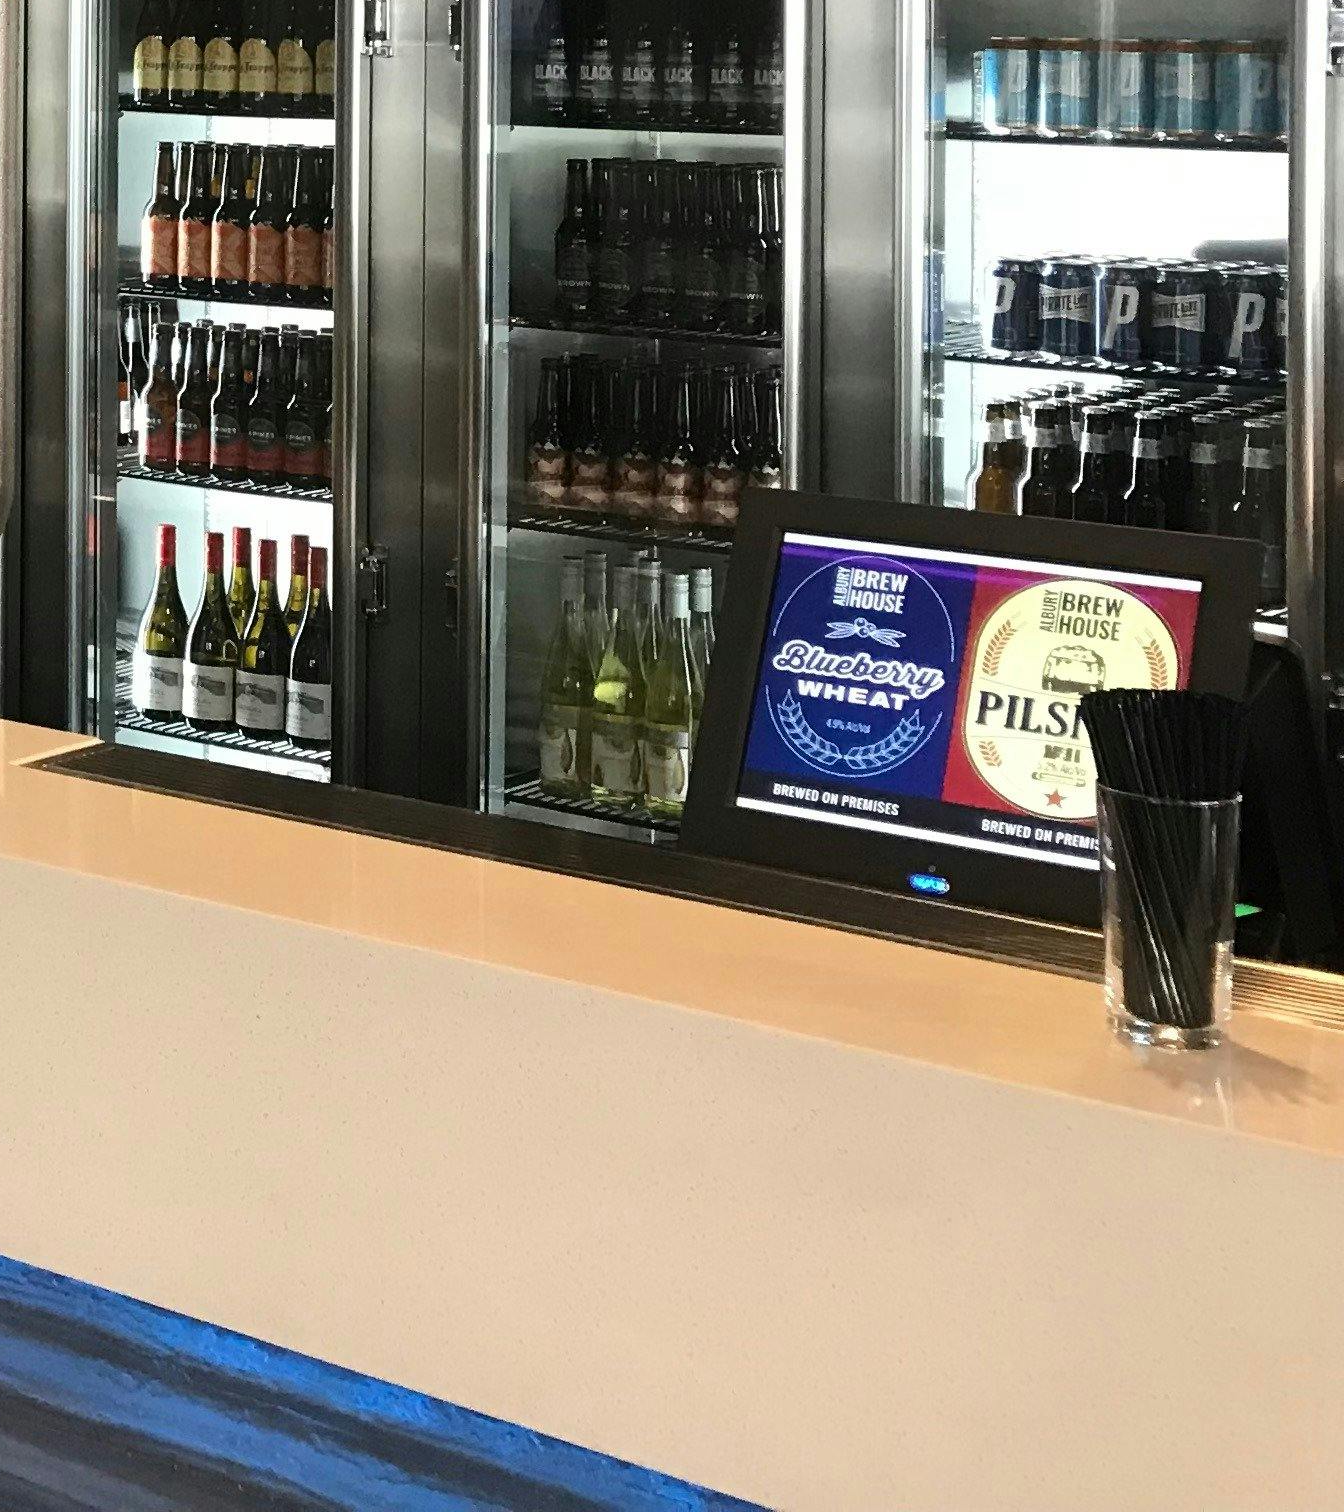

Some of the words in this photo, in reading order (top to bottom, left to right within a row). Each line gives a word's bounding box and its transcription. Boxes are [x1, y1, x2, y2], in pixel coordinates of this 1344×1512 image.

[833, 565, 852, 606] ALBURY
[852, 568, 909, 594] BREW
[849, 589, 906, 615] HOUSE
[1039, 589, 1060, 633] ALBURY
[1061, 591, 1125, 619] BREW
[1058, 614, 1123, 642] HOUSE
[773, 639, 945, 700] Blueberry
[797, 679, 910, 711] WHEAT
[975, 690, 1084, 740] PILS
[772, 782, 819, 802] BREWED
[821, 790, 839, 806] ON
[841, 794, 900, 816] PREMISES
[981, 818, 1032, 838] BREWED
[1034, 828, 1053, 842] ON
[1055, 831, 1100, 851] PREMIS
